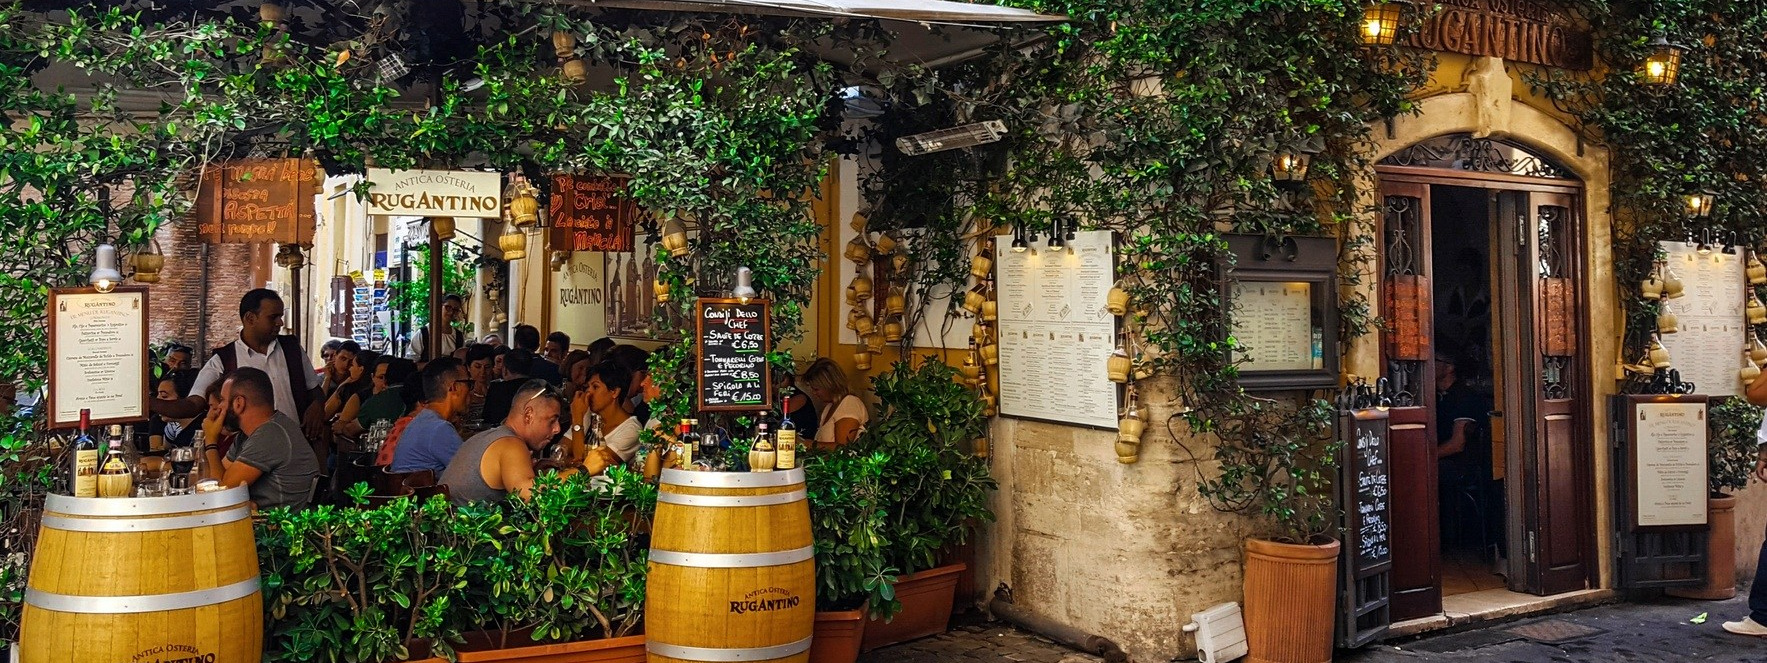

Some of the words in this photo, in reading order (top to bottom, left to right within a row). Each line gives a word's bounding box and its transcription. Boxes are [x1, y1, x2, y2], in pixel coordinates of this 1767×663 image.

[395, 175, 433, 191] ANTICA
[435, 175, 477, 193] OSTERIA
[371, 190, 498, 213] RUGANTINO
[579, 262, 598, 282] OSTERIA
[560, 285, 602, 307] RUGANTINO
[745, 589, 767, 600] ANTICA
[768, 587, 790, 597] OSTERIA
[730, 596, 799, 614] RUGANTINO
[132, 646, 164, 663] ANTICA
[165, 644, 199, 655] OSTERIA
